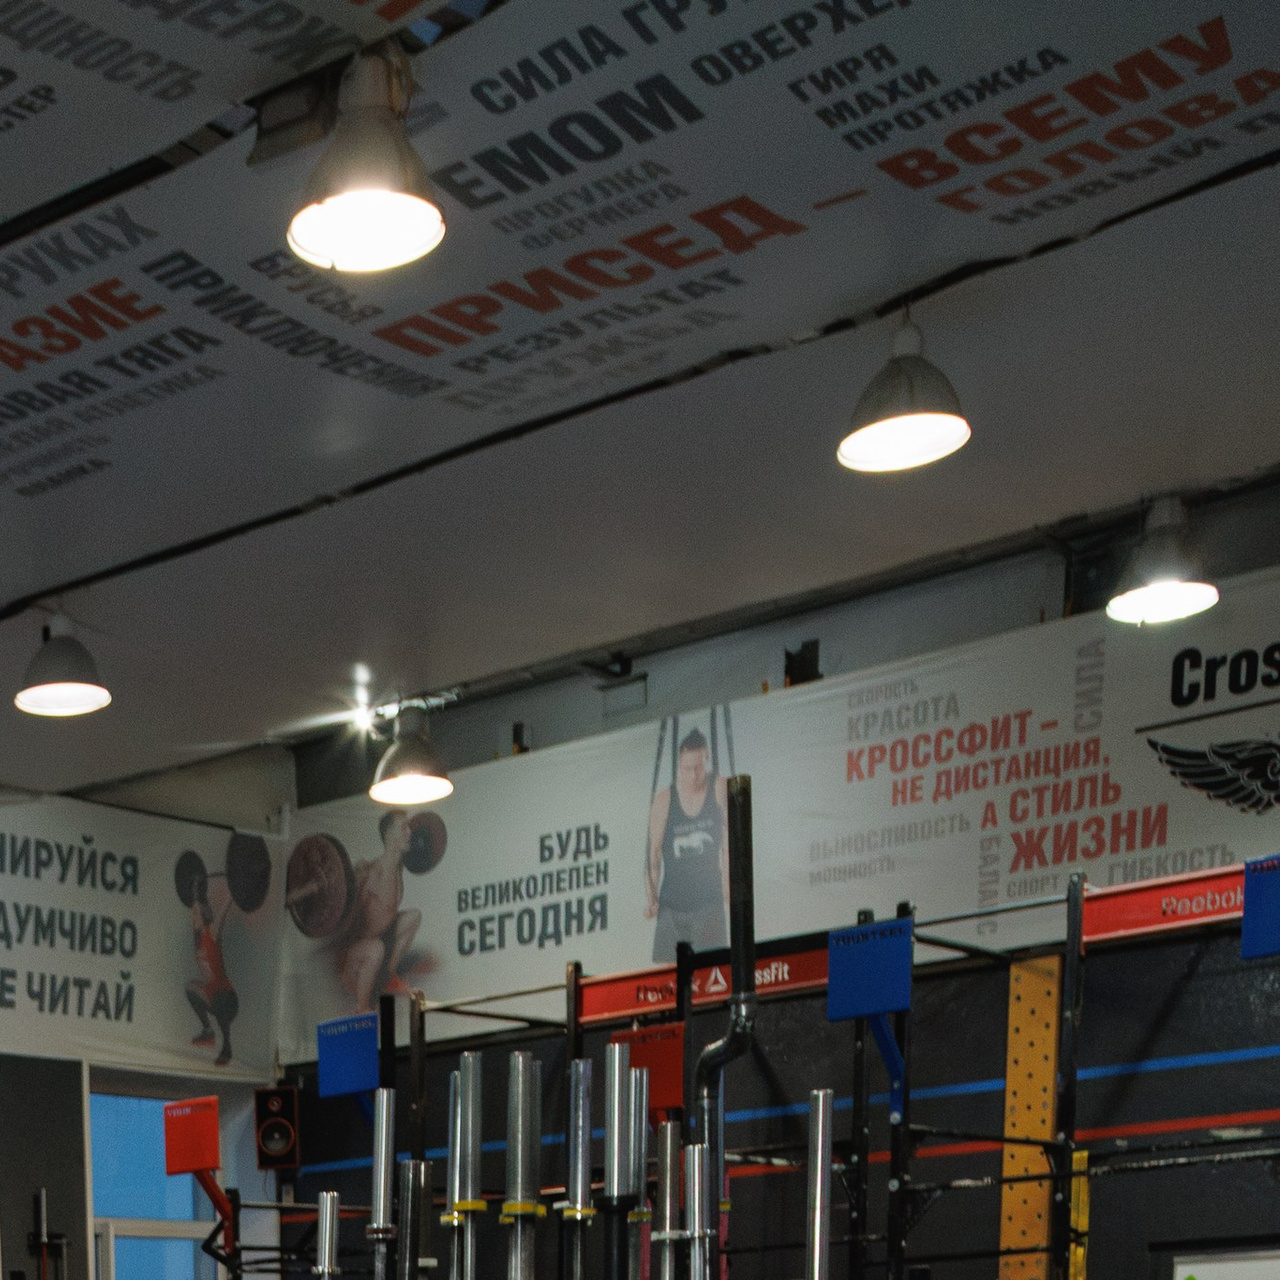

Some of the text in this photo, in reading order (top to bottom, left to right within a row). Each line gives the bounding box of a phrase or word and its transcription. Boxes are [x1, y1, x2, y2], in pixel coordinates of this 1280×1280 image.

[470, 24, 628, 116] СИЛА
[690, 0, 912, 86] ОВЕРХЕ
[787, 42, 900, 105] ГИРЯ
[815, 65, 941, 130] МАХИ
[842, 45, 1072, 152] ПРОТЯЖКА
[935, 67, 1280, 214] ГОЛОВА
[371, 195, 808, 357] ПРИСЕД
[876, 14, 1233, 190] ВСЕМУ
[491, 158, 672, 236] ПРОГУЛКА
[520, 181, 690, 251] ФЕРМЕРА
[95, 325, 223, 382] ТЯГА
[454, 268, 747, 375] РЕЗУЛЬТАТ
[1073, 635, 1107, 733] СИЛА
[846, 709, 1033, 783] КРОССФИТ
[847, 692, 960, 742] КРАСОТА
[891, 736, 1110, 807] НЕ ДИСТАНЦИЯ,
[980, 771, 1122, 830] А СТИЛЬ
[540, 822, 609, 865] БУДЬ
[810, 813, 972, 862] ВЫНОСЛИВОСТЬ
[1008, 802, 1169, 873] ЖИЗНИ
[1108, 844, 1235, 885] ГИБКОСТЬ
[457, 859, 608, 913] ВЕЛИКОЛЕПЕН
[1006, 875, 1059, 898] СПОРТ
[457, 894, 608, 957] СЕГОДНЯ
[26, 971, 135, 1023] ЧИТАЙ
[754, 961, 790, 985] ssFit
